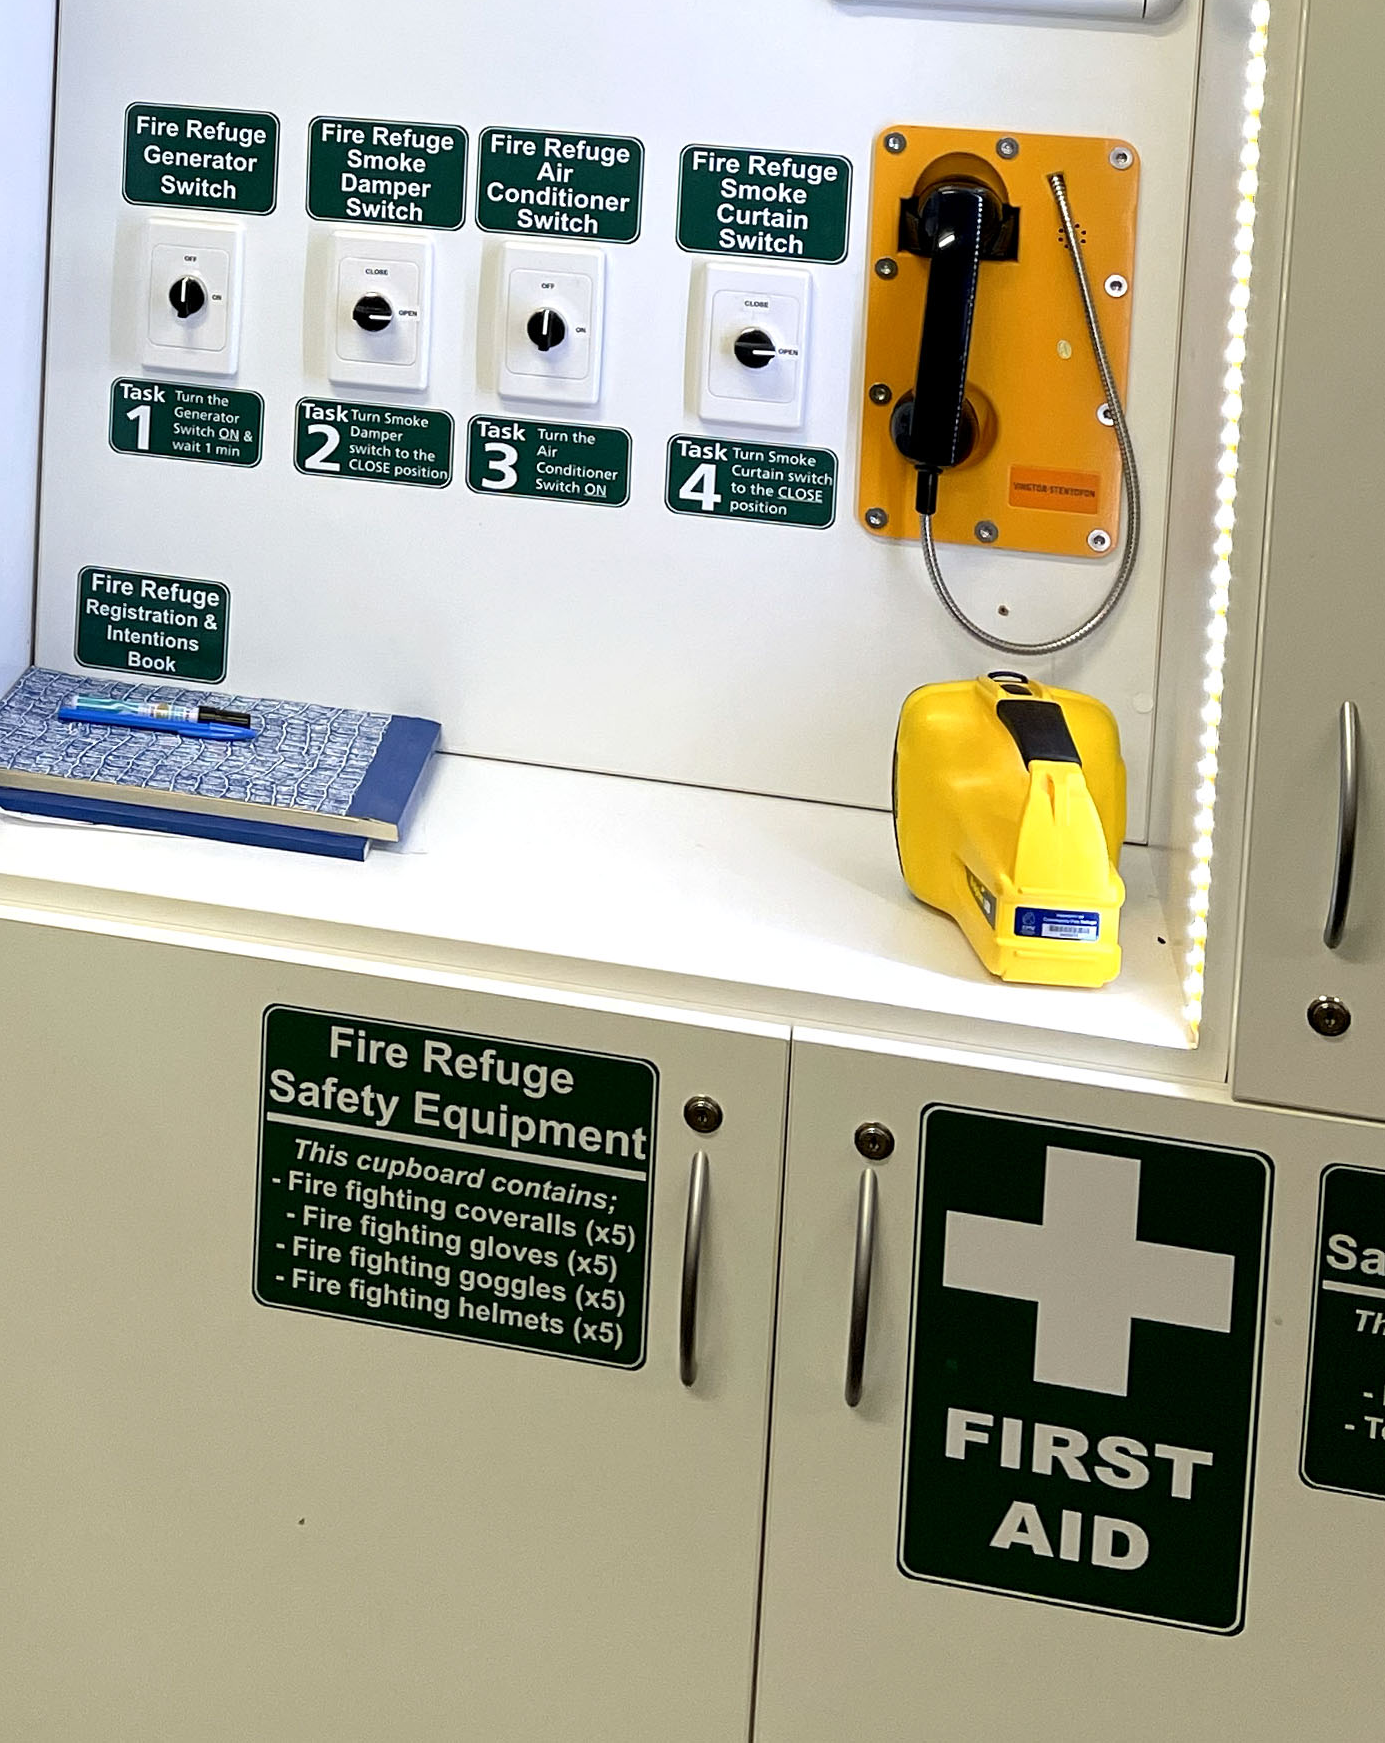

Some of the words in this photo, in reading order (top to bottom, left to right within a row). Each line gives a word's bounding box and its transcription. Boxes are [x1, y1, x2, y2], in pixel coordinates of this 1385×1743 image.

[136, 115, 178, 137] Fire
[186, 119, 266, 147] Refuge
[143, 145, 257, 172] Generator
[692, 150, 739, 173] Fire
[748, 155, 837, 185] Refuge
[160, 174, 235, 199] Switch
[720, 178, 806, 204] Smoke
[716, 203, 807, 230] Curtain
[718, 228, 802, 255] Switch
[744, 300, 769, 308] CLOSE
[778, 348, 798, 356] OPEN
[119, 380, 165, 403] Task
[175, 390, 203, 404] Turn
[207, 393, 228, 407] the
[174, 406, 239, 424] Generator
[123, 406, 150, 455] 1
[173, 422, 214, 437] Switch
[218, 427, 239, 442] ON
[243, 430, 252, 442] &
[172, 441, 200, 453] wait
[205, 443, 210, 453] 1
[215, 446, 239, 457] min
[676, 436, 727, 461] Task
[677, 463, 721, 517] 4
[92, 573, 133, 596] Fire
[141, 579, 220, 610] Refuge
[87, 598, 198, 628] Registration
[203, 614, 217, 630] &
[107, 624, 199, 652] Intentions
[127, 651, 176, 672] Book
[330, 1025, 407, 1068] Fire
[423, 1039, 573, 1098] Refuge
[269, 1069, 399, 1127] Safety
[414, 1090, 646, 1160] Equipment
[295, 1138, 348, 1167] This
[356, 1154, 485, 1189] cupboard
[491, 1176, 616, 1215] contains;
[288, 1170, 337, 1197] Fire
[345, 1179, 445, 1221] fighting
[455, 1203, 576, 1237] coveralls
[585, 1219, 634, 1253] (x5)
[945, 1407, 1213, 1499] FIRST
[989, 1500, 1150, 1571] AID
